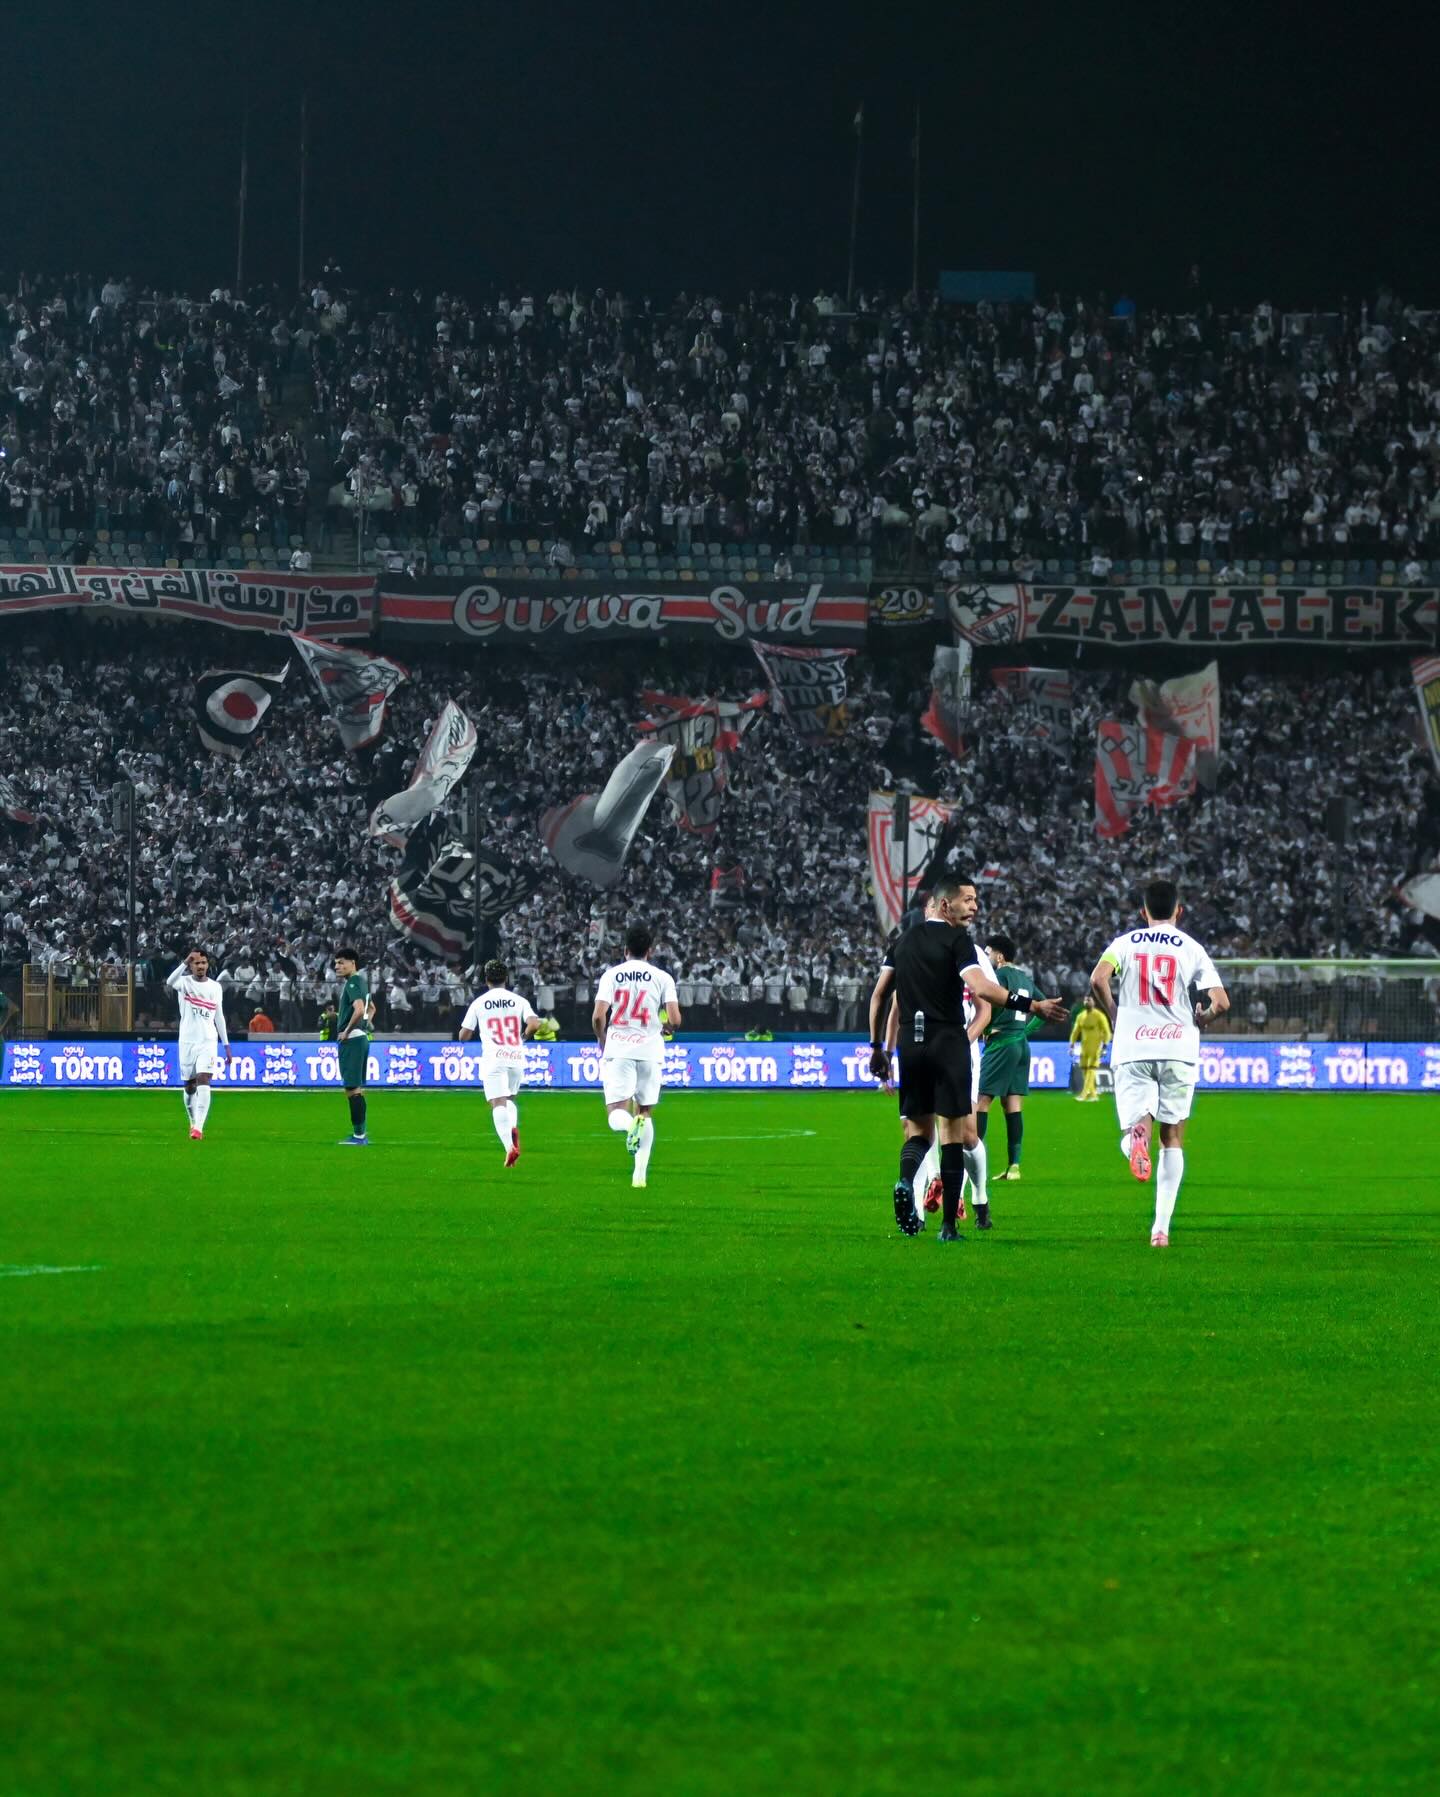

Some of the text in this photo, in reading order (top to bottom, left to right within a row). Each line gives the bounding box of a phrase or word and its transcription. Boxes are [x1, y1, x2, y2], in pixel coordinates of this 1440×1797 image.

[453, 583, 823, 640] Curva Sud
[880, 588, 923, 612] 20
[1033, 587, 1435, 642] ZAMALEK
[1130, 932, 1184, 948] ONIRO
[615, 971, 652, 983] ONIRO
[1134, 952, 1178, 1006] 13
[484, 999, 516, 1010] ONIRO
[612, 988, 651, 1027] 24
[487, 1015, 520, 1046] 33
[51, 1056, 123, 1080] TORTA
[210, 1056, 256, 1080] RTA
[429, 1056, 483, 1081] TORT
[699, 1056, 777, 1082] TORTA
[1199, 1057, 1270, 1083] ORTA
[1324, 1057, 1409, 1084] TORTA
